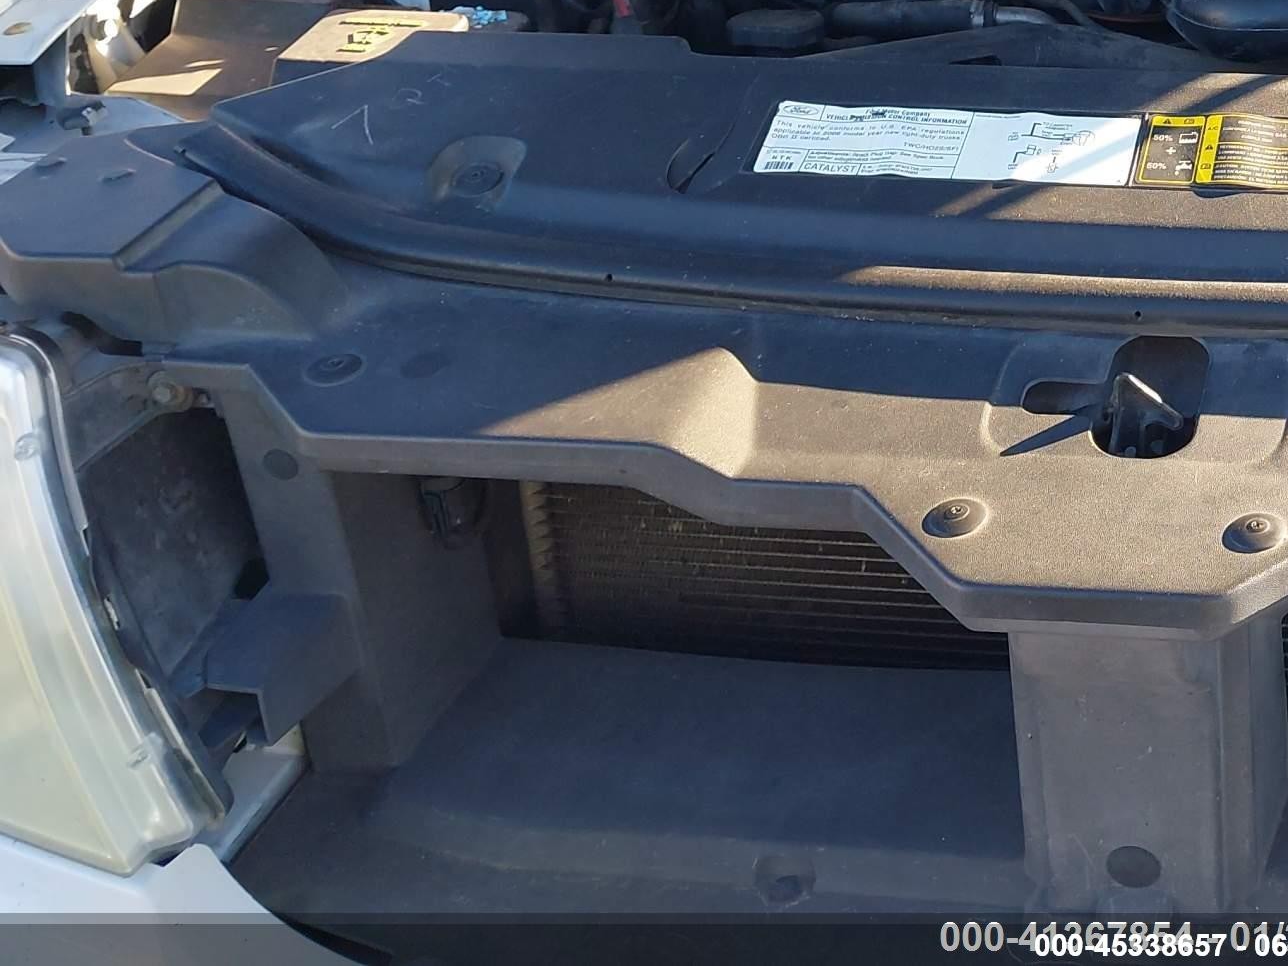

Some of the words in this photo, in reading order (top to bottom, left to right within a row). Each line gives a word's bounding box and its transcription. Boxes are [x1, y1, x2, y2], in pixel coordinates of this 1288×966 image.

[888, 114, 919, 122] CONTROL
[921, 116, 967, 125] INFORMATION
[803, 162, 857, 173] CATALYST
